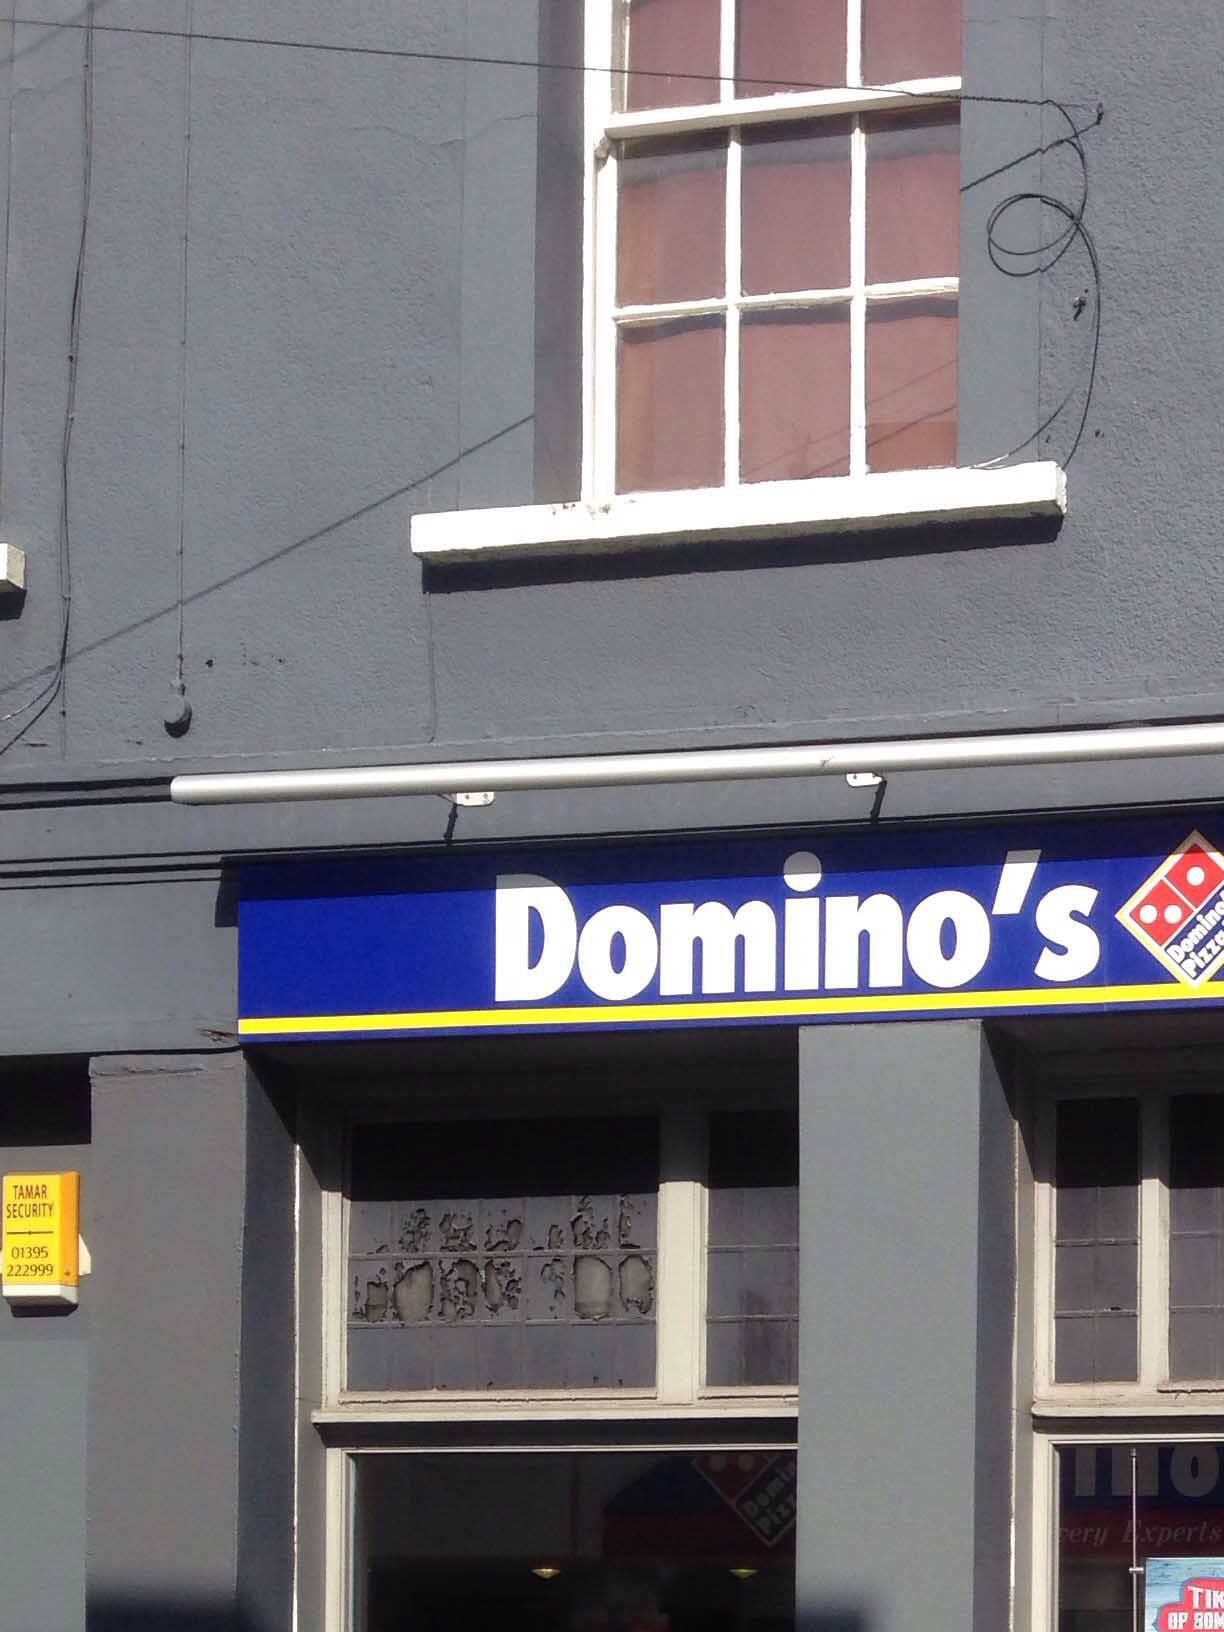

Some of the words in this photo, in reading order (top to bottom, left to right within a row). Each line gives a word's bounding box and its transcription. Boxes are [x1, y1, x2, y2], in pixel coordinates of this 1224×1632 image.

[494, 849, 1102, 1002] Domino's
[12, 1184, 48, 1200] TAMAR
[6, 1202, 55, 1219] SECURITY
[11, 1246, 49, 1259] 01395
[6, 1263, 55, 1278] 222999
[1167, 1612, 1188, 1630] OF
